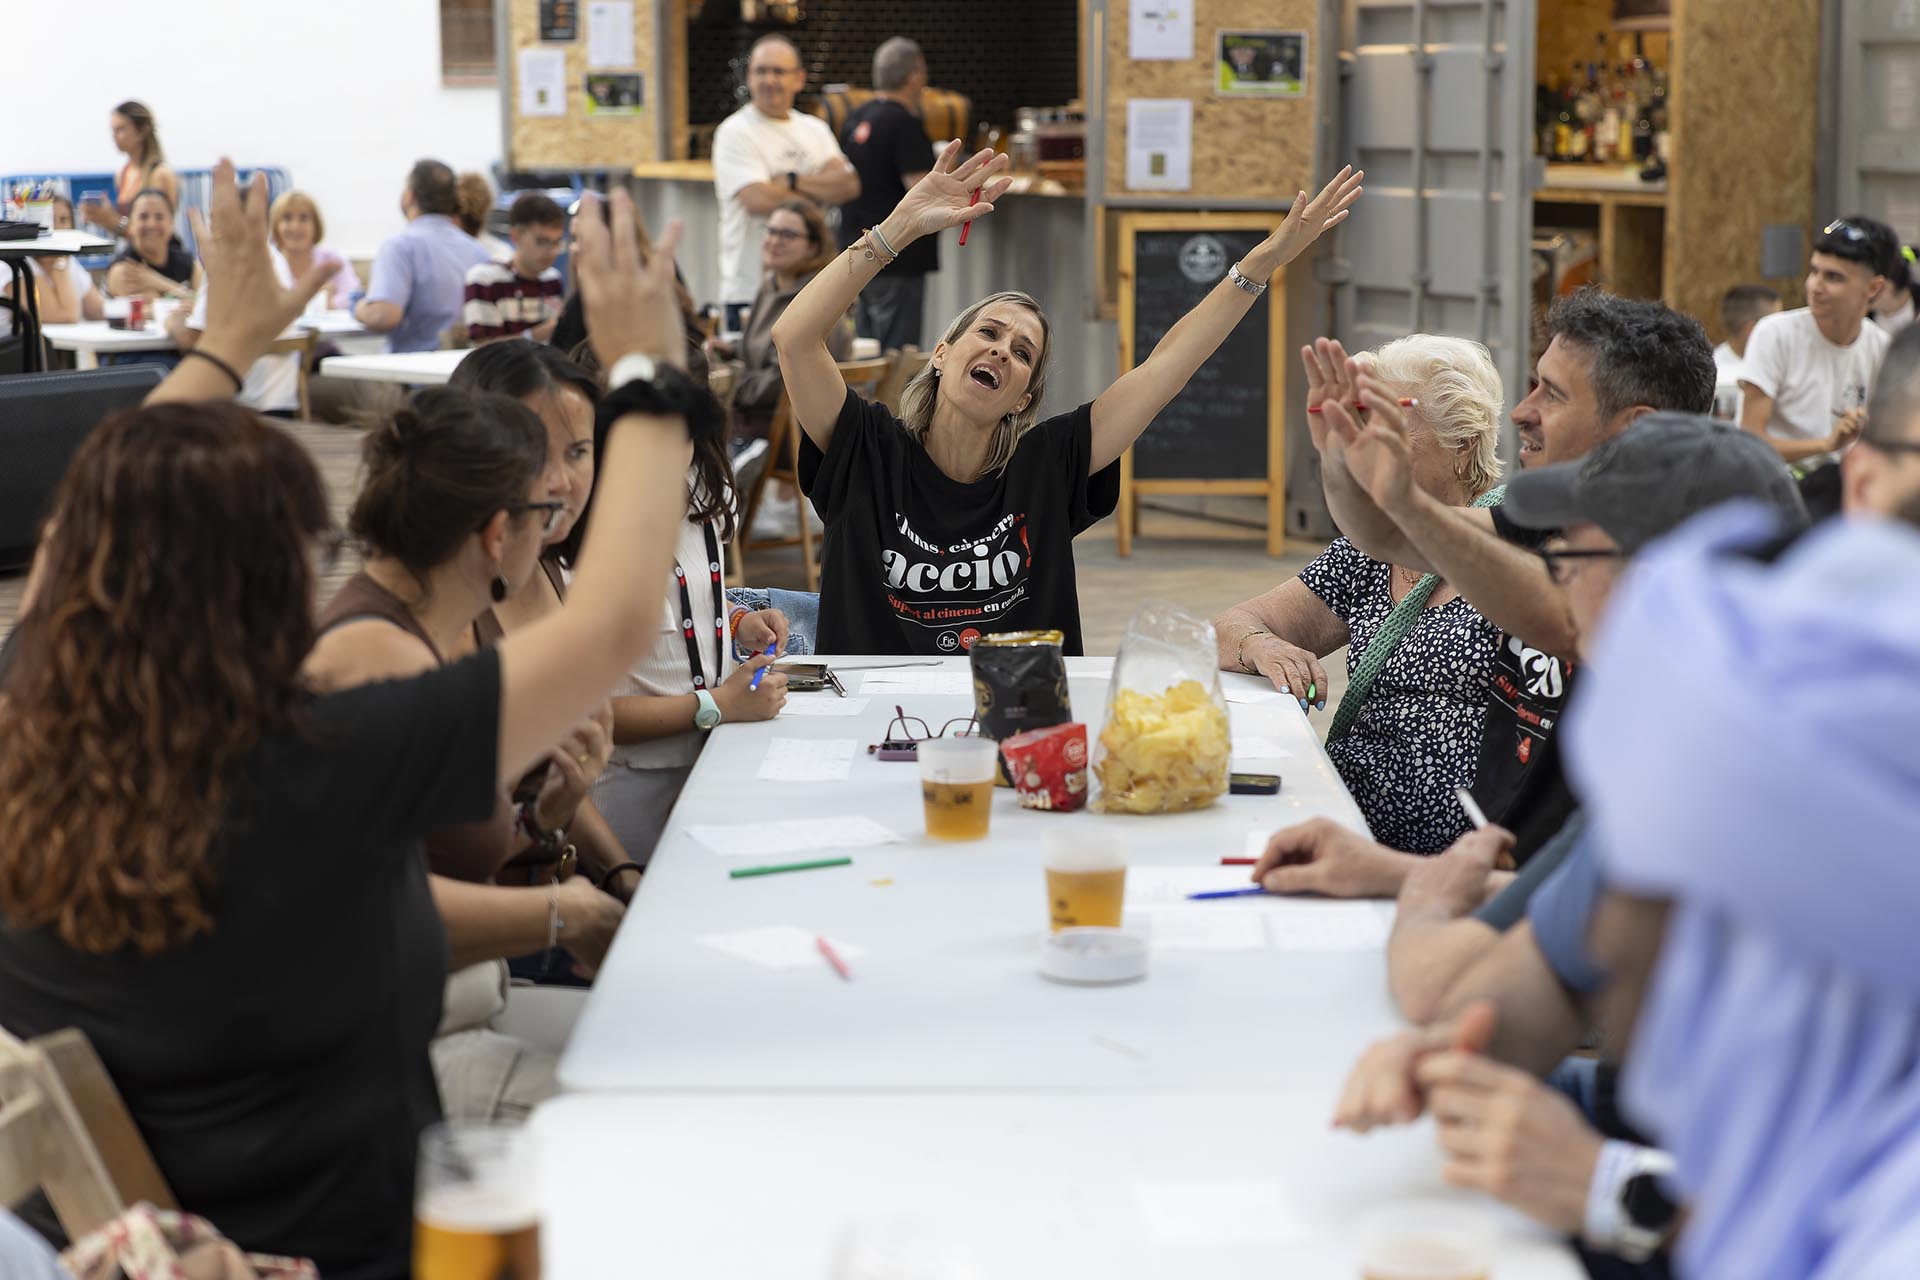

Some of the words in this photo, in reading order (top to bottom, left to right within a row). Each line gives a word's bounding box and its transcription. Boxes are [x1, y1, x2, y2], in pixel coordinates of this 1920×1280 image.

[923, 608, 935, 619] al
[937, 607, 982, 619] cinema
[984, 603, 999, 613] en
